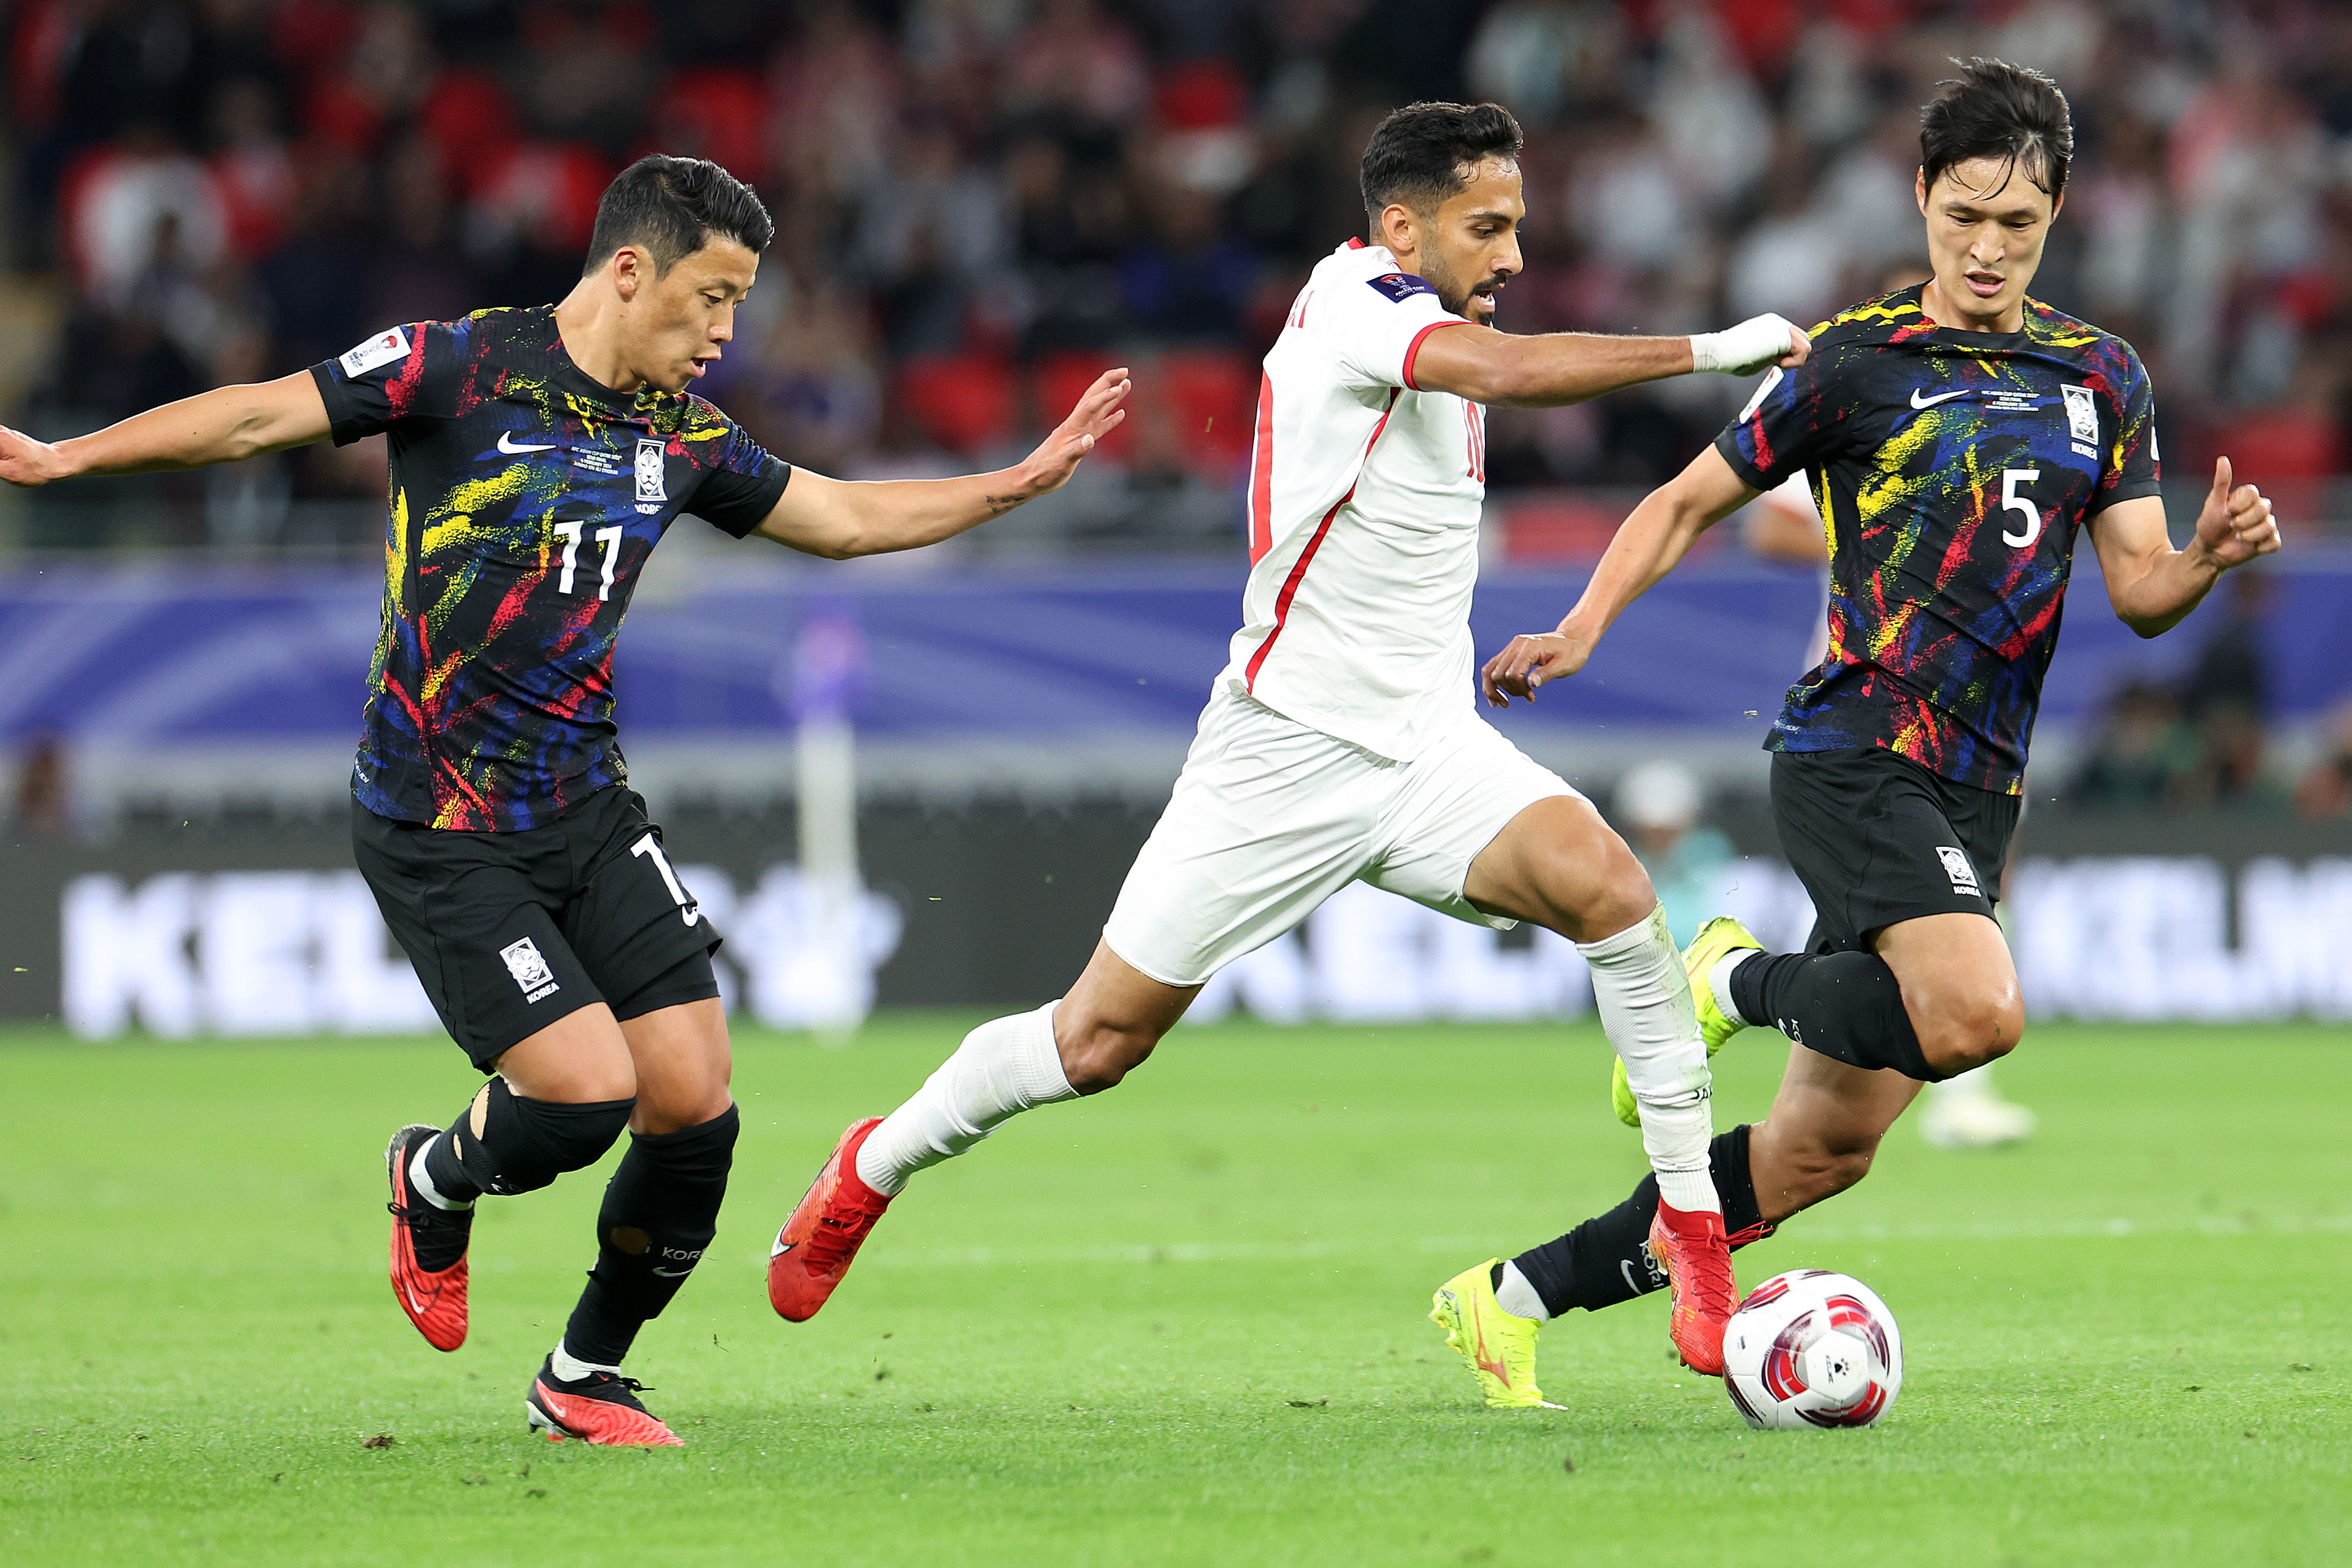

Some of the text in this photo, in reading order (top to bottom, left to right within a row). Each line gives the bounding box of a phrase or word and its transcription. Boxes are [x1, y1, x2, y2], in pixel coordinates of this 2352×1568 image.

[2071, 441, 2098, 461] KOREA
[634, 503, 664, 515] KORE
[2001, 469, 2042, 548] 5
[553, 520, 623, 601] 11
[1953, 885, 1982, 898] KOREA
[526, 982, 560, 1004] KOREA
